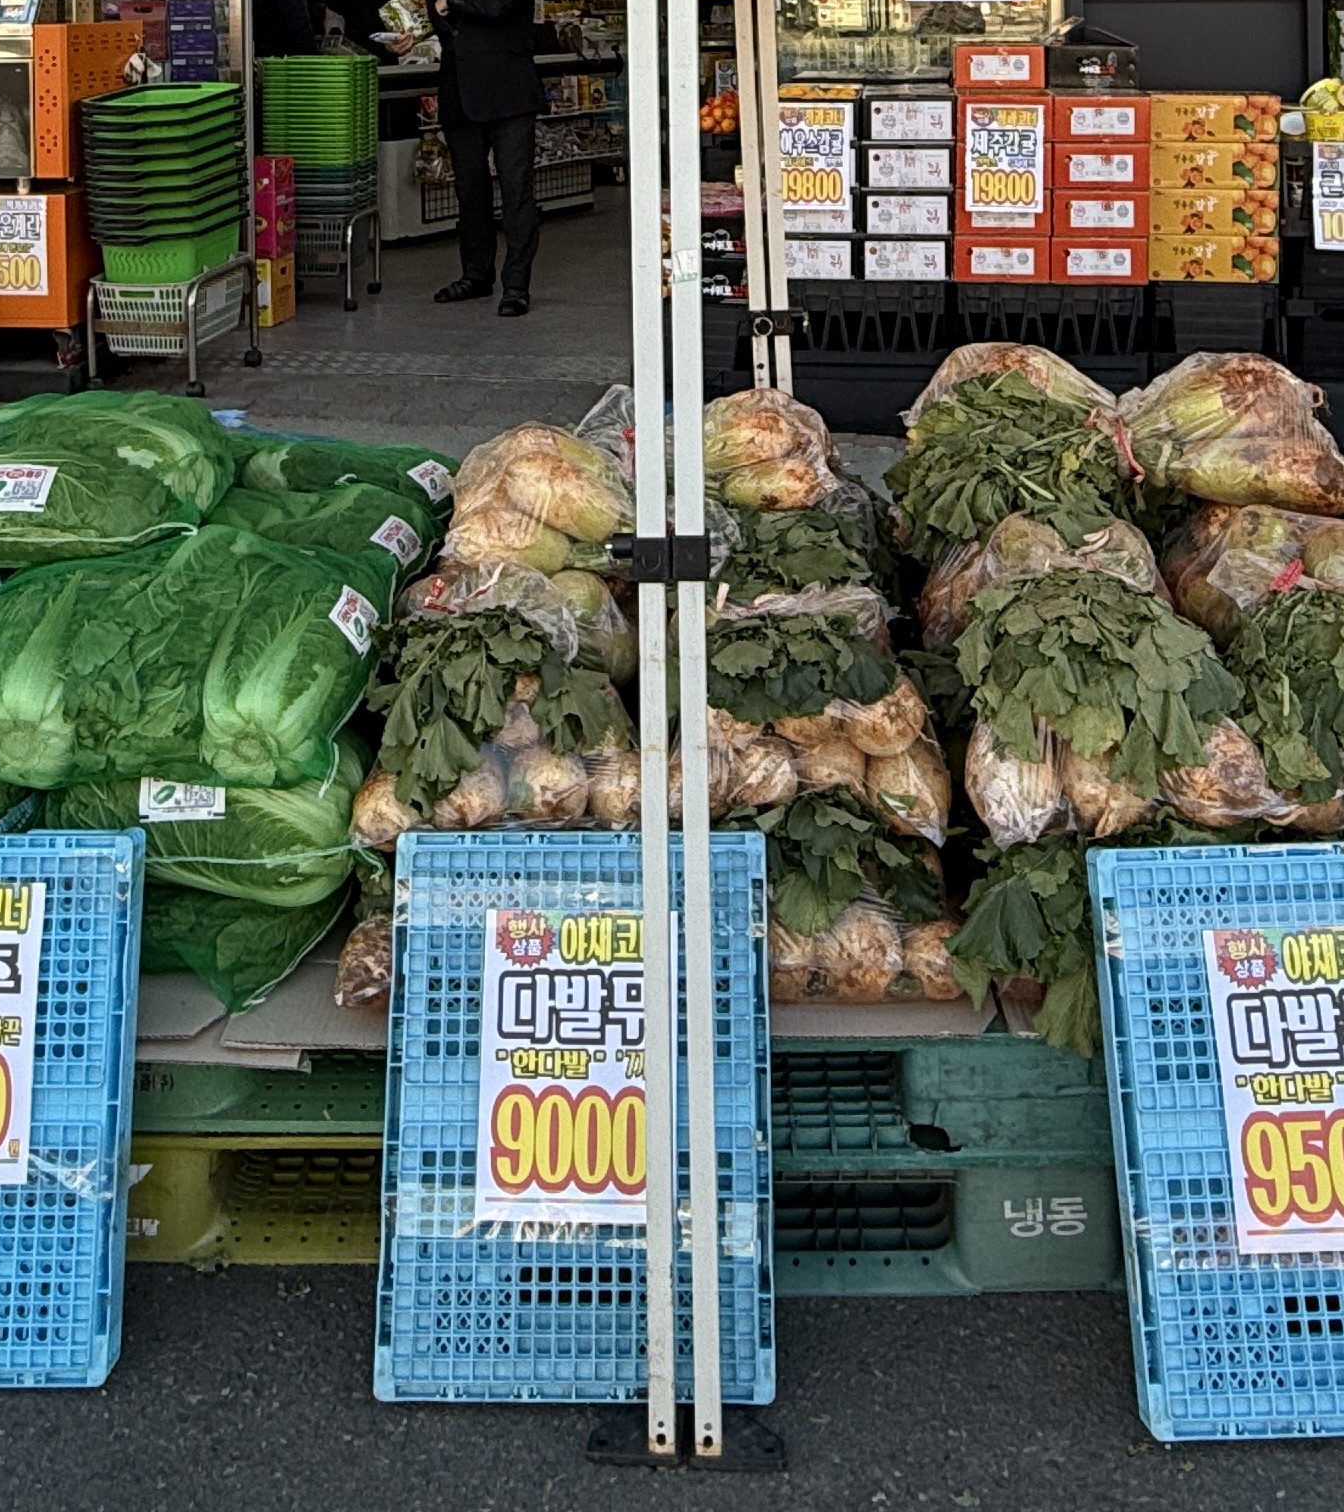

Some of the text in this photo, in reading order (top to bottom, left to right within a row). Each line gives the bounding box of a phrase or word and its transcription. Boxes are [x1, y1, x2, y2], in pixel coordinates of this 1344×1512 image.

[780, 129, 844, 156] 하우스감귤
[971, 129, 1037, 157] 제주감귤
[781, 168, 844, 203] 19800
[971, 169, 1035, 205] 19800
[508, 915, 644, 964] 행사 야채코
[512, 938, 543, 956] 상품
[1226, 938, 1266, 960] 행사
[1234, 961, 1266, 978] 상품
[497, 968, 644, 1046] 다발무
[491, 1084, 646, 1195] 9000
[1004, 1197, 1088, 1238] 냉동
